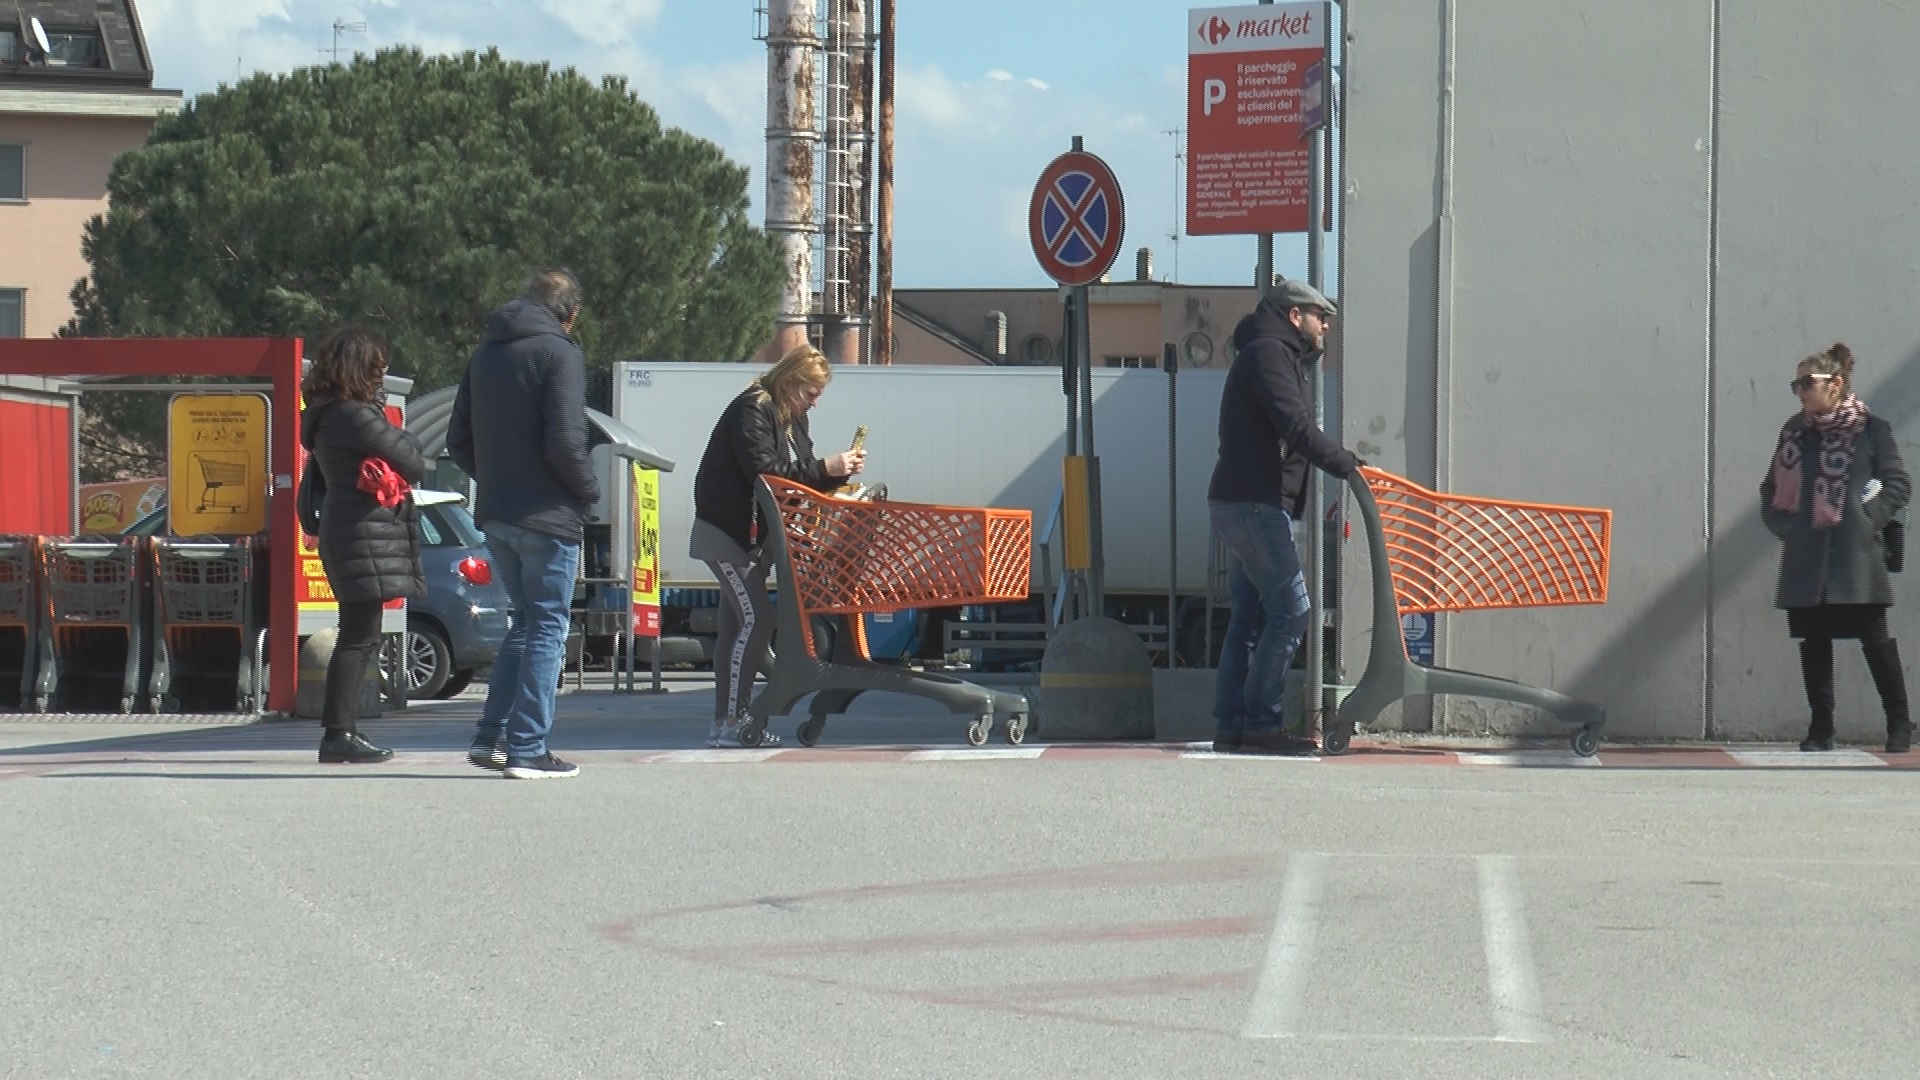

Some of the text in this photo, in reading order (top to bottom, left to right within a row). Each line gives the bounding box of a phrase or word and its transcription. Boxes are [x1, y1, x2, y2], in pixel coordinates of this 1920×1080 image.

[1236, 10, 1312, 38] market
[1237, 60, 1297, 75] Il parcheggio
[1237, 75, 1287, 86] è riservato
[1204, 79, 1227, 117] P
[1237, 98, 1292, 112] ai clienti del
[1284, 178, 1308, 186] SOCIET
[1196, 190, 1231, 198] GENERALE
[1240, 188, 1291, 197] SUPERMERCATI
[630, 370, 650, 379] FRC
